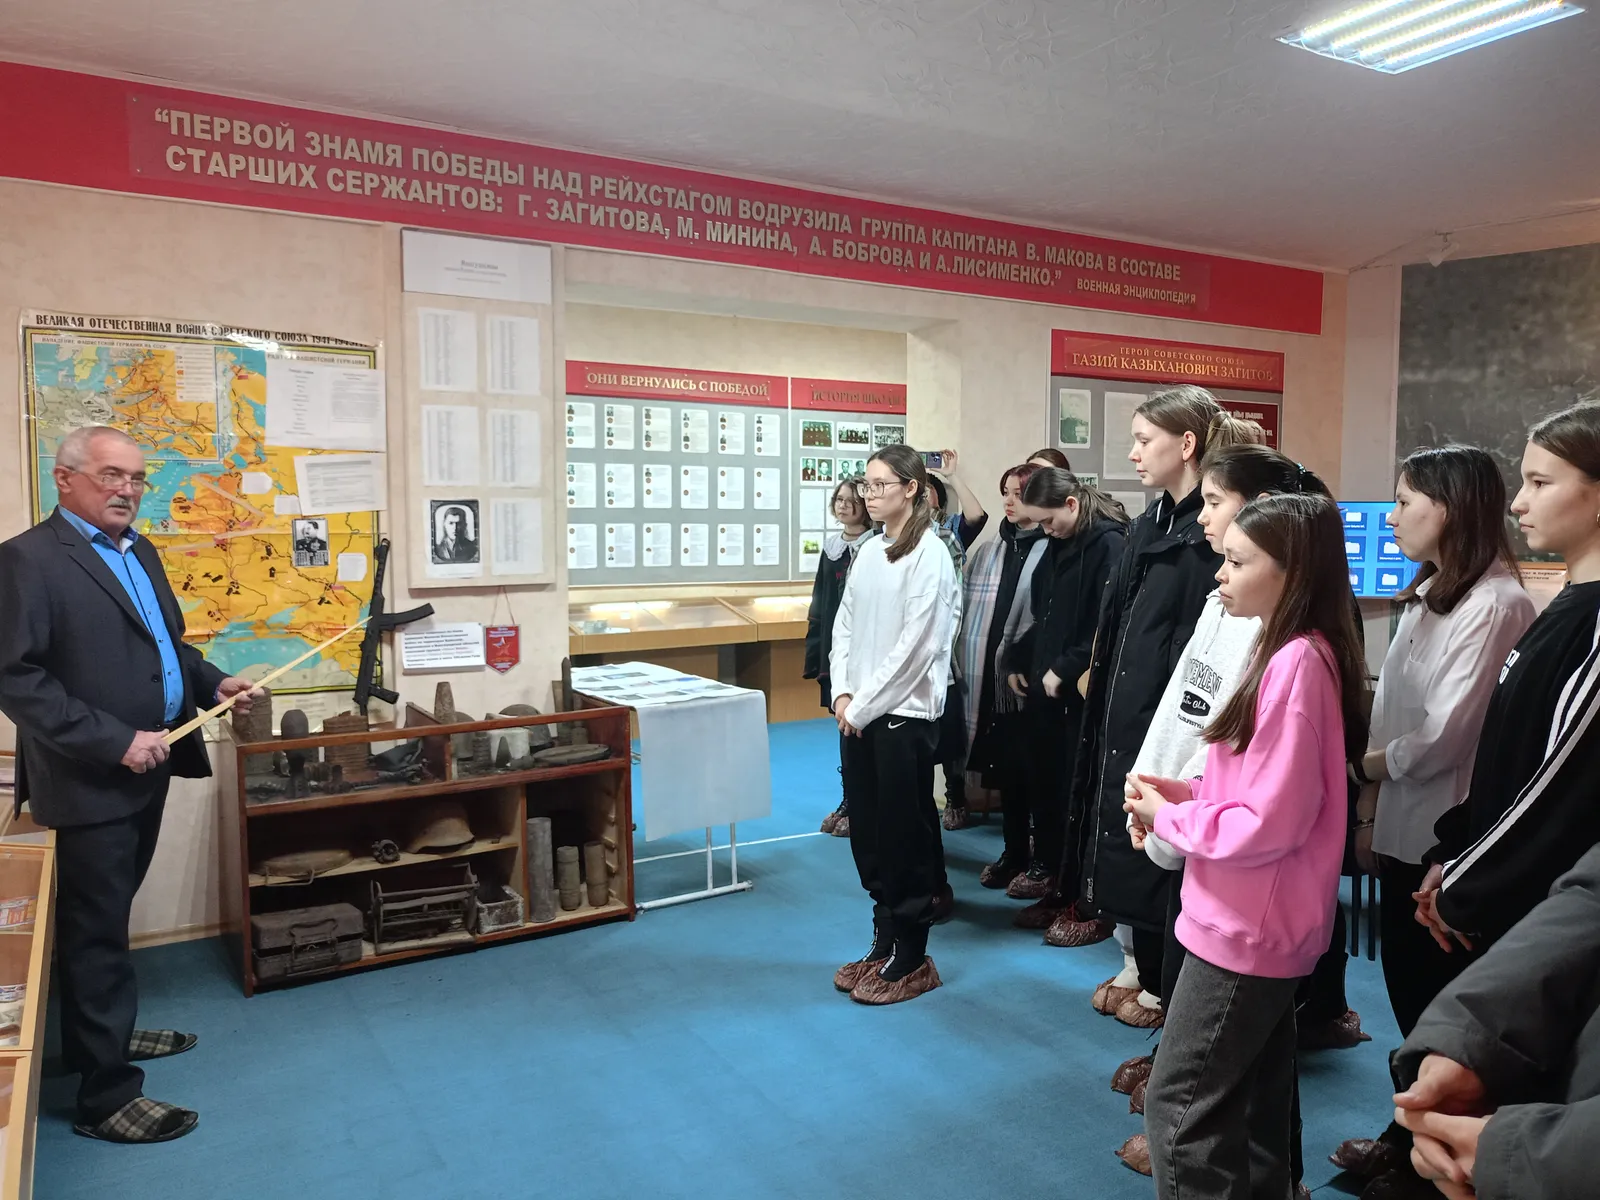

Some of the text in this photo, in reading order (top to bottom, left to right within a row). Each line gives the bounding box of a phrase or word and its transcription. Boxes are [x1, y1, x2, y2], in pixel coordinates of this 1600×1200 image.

[165, 145, 318, 190] СТАРШИХ
[326, 167, 503, 213] СЕРЖАНТОВ:
[518, 194, 539, 218] Г.
[546, 198, 671, 240] ЗАГИТОВА,
[677, 215, 700, 240] М.
[706, 220, 798, 257] МИНИНА,
[808, 235, 827, 257] А.
[832, 238, 915, 268] БОБРОВА
[919, 251, 931, 270] И
[304, 131, 402, 168] ЗНАМЯ
[412, 148, 524, 187] ПОБЕДЫ
[533, 166, 583, 199] НАД
[590, 175, 732, 217] РЕЙХСТАГОМ
[738, 199, 852, 234] ВОДРУЗИЛА
[861, 217, 927, 245] ГРУППА
[932, 228, 1018, 258] КАПИТАНА
[1026, 242, 1040, 261] В.
[1045, 246, 1104, 271] МАКОВА
[1107, 256, 1117, 272] В
[1120, 257, 1181, 281] СОСТАВЕ
[1077, 277, 1196, 305] ВОЕННАЯ ЭНЦИКЛОПЕДИЯ
[36, 314, 84, 328] ВЕЛИКАЯ
[89, 317, 171, 333] ОТЕЧЕСТВЕННАЯ
[176, 321, 207, 335] ВОЙНА
[275, 331, 308, 343] СОЮЗА
[1072, 352, 1274, 381] ГАЗИЙ КАЗЫХАНОВИЧ ЗАГИТОВ
[1119, 346, 1245, 366] ГЕРОЙ СОВЕТСКОГО СОЮЗА
[587, 372, 768, 397] ОНИ ВЕРНУЛИСЬ С ПОБЕДОЙ
[812, 390, 860, 403] ИСТОРИЯ
